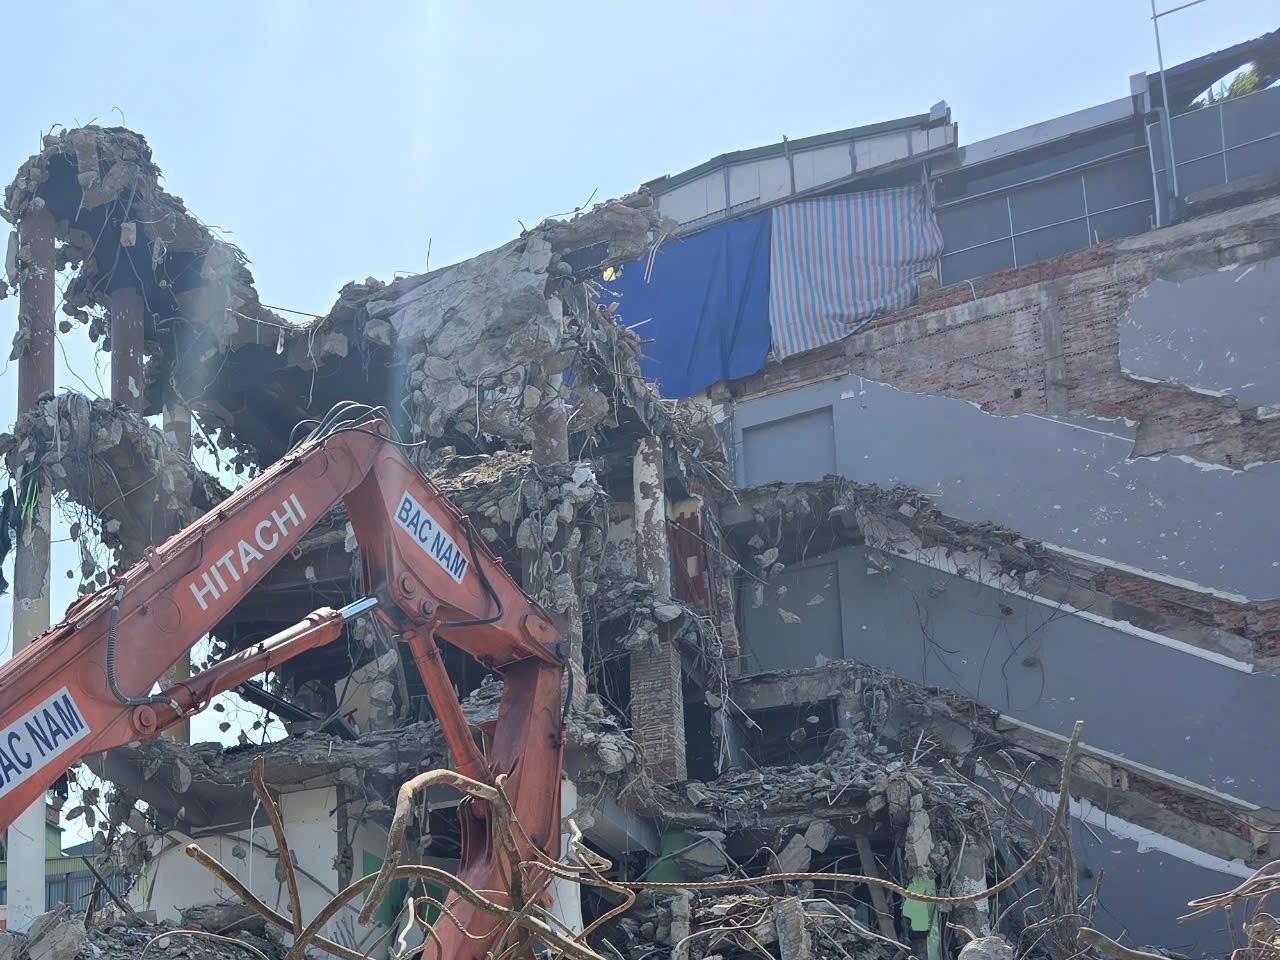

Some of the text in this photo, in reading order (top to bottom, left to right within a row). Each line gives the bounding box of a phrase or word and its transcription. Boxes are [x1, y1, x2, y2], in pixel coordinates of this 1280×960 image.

[189, 492, 307, 611] HITACHI
[397, 496, 467, 580] BAC NAM
[24, 693, 85, 758] NAM
